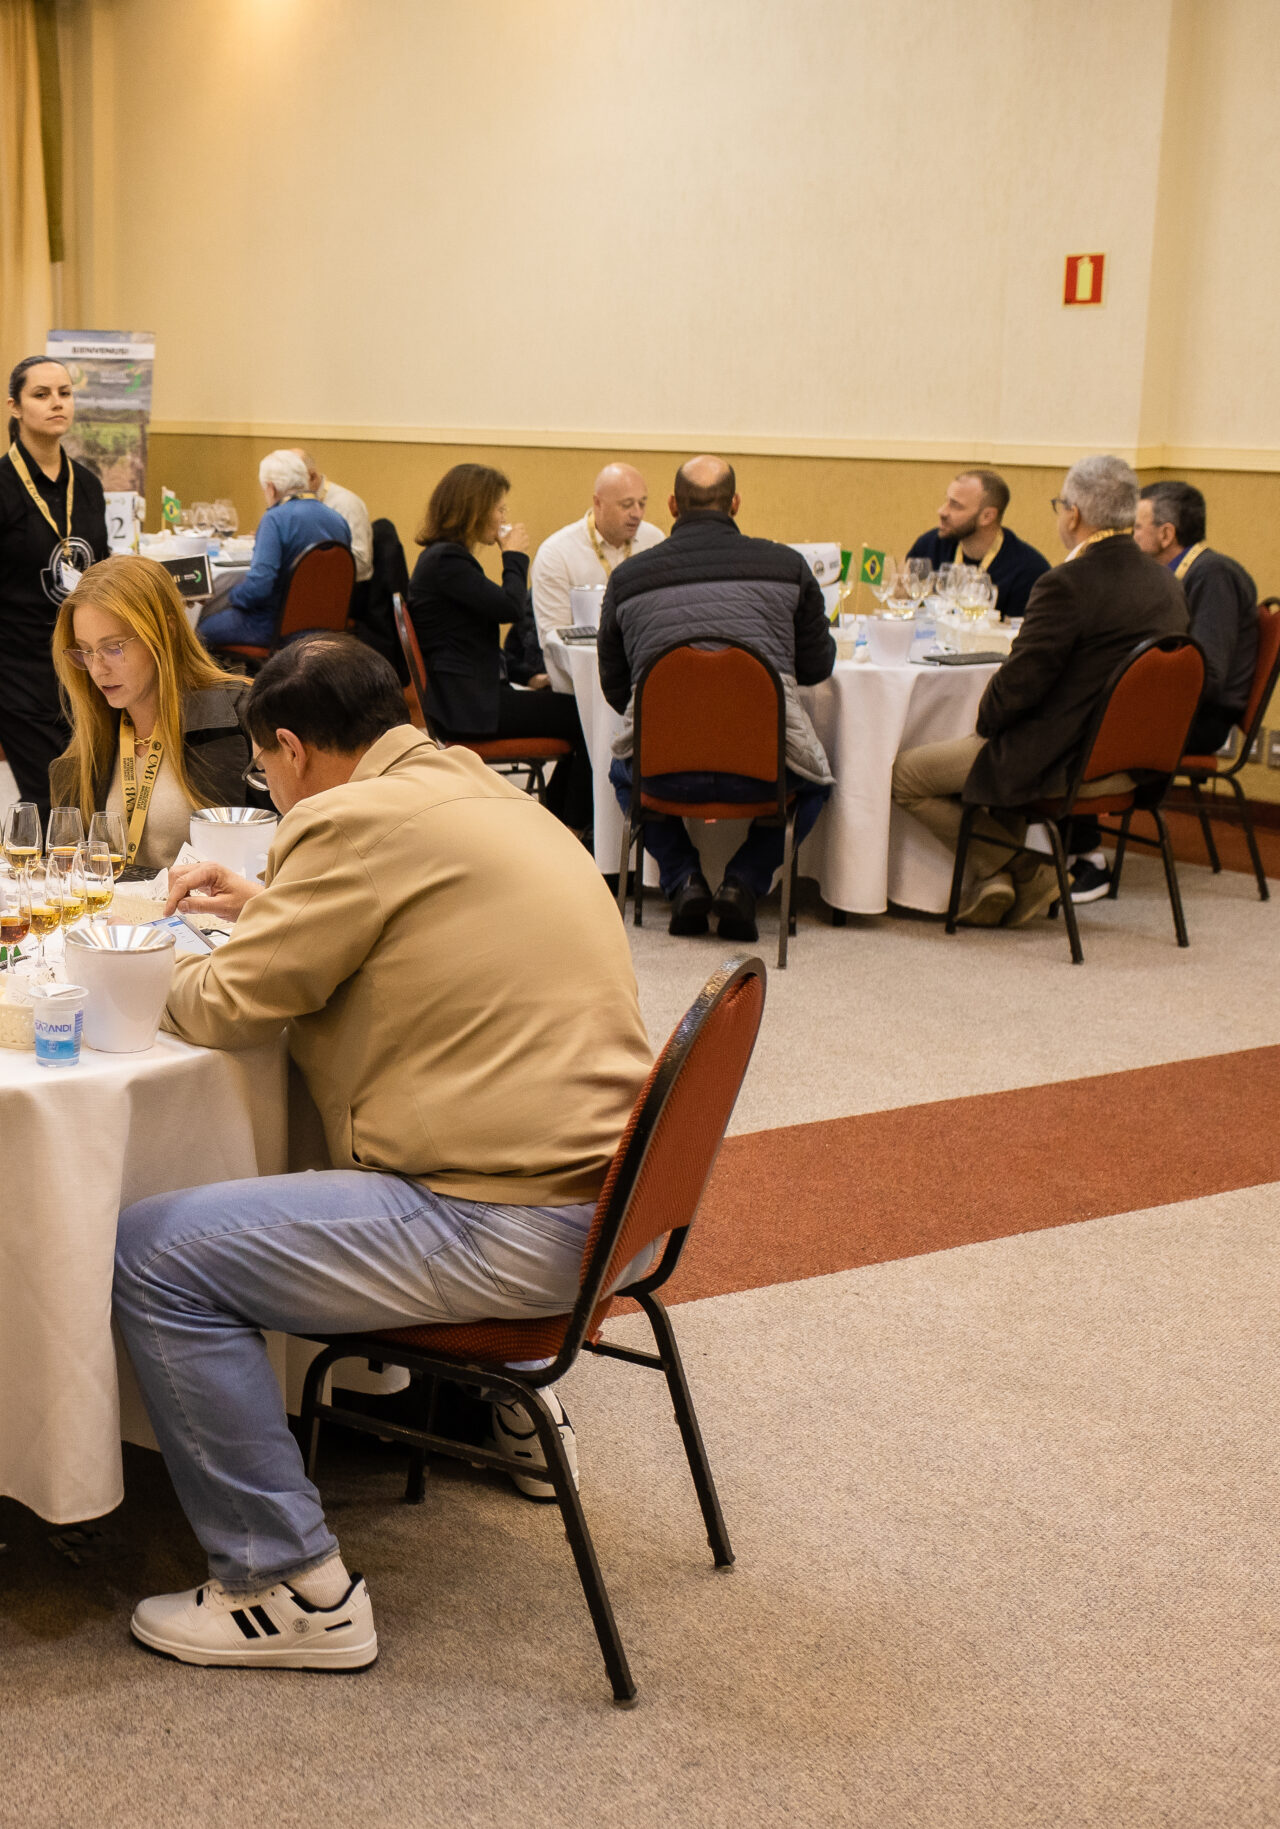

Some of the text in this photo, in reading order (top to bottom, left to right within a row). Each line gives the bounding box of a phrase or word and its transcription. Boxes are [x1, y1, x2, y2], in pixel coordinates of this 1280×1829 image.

[111, 516, 126, 539] 2
[144, 754, 159, 780] CMB
[124, 786, 136, 813] CMB
[35, 1021, 71, 1033] SARANDI
